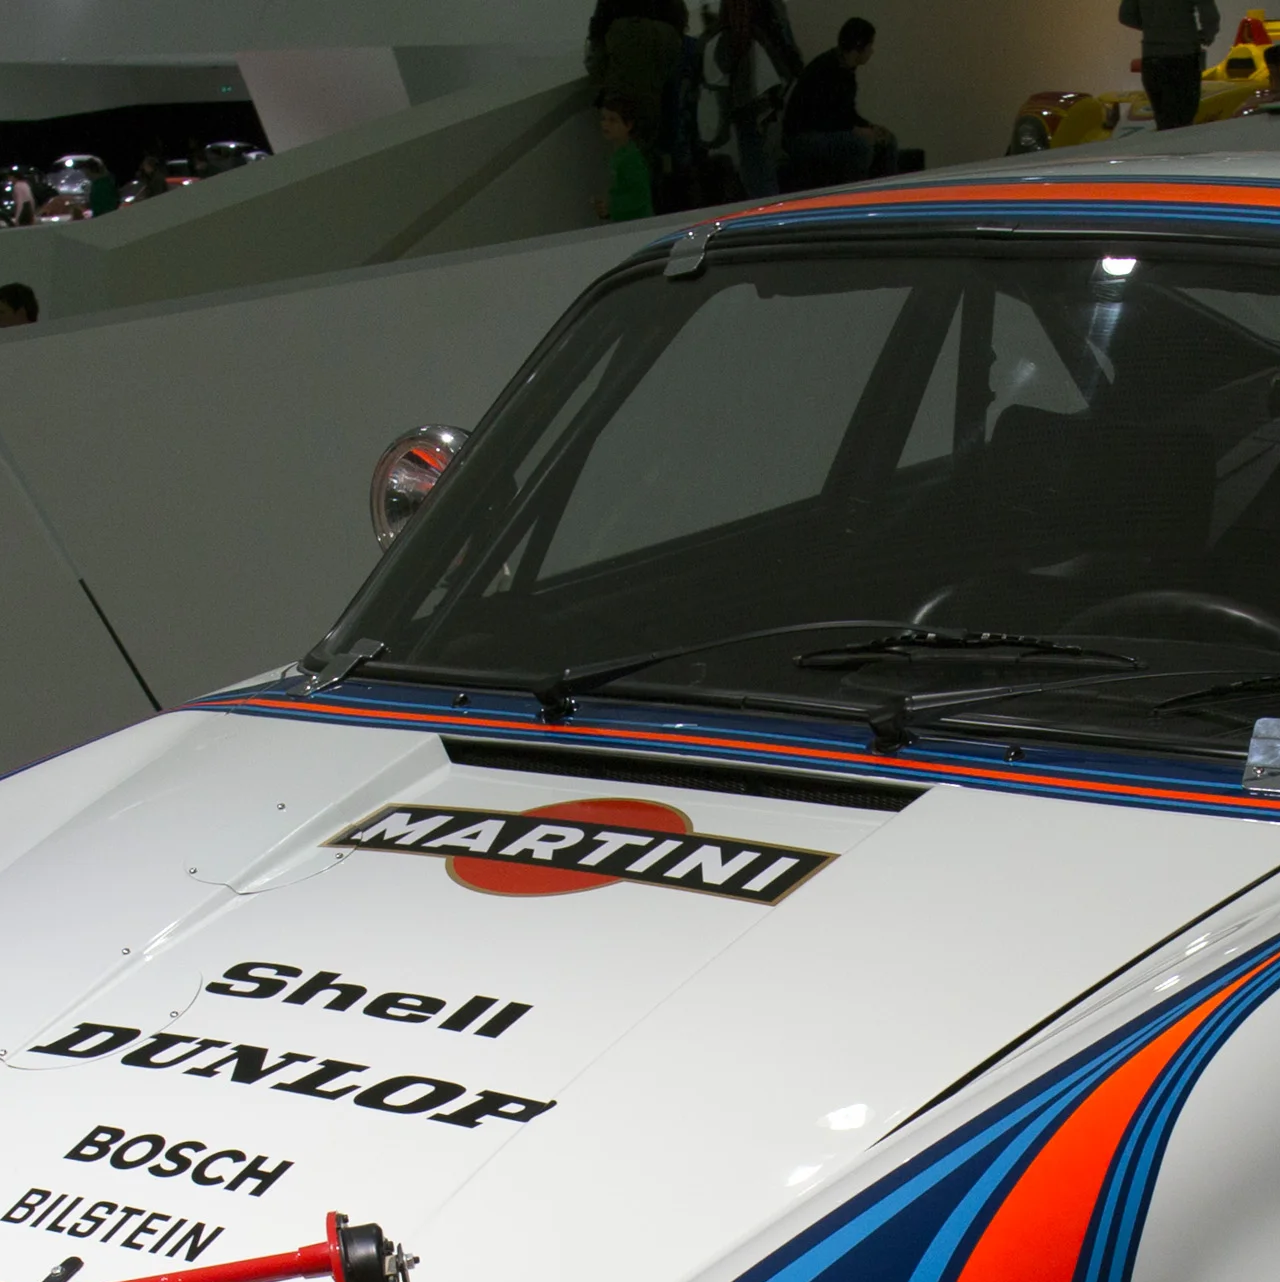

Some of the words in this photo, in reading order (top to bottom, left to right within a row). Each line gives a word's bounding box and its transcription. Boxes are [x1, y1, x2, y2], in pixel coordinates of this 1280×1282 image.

[357, 811, 801, 894] MARTINI
[204, 961, 535, 1039] Shell
[26, 1021, 558, 1130] DUNLOP
[63, 1124, 295, 1198] BOSCH
[0, 1187, 226, 1264] BILSTEIN
